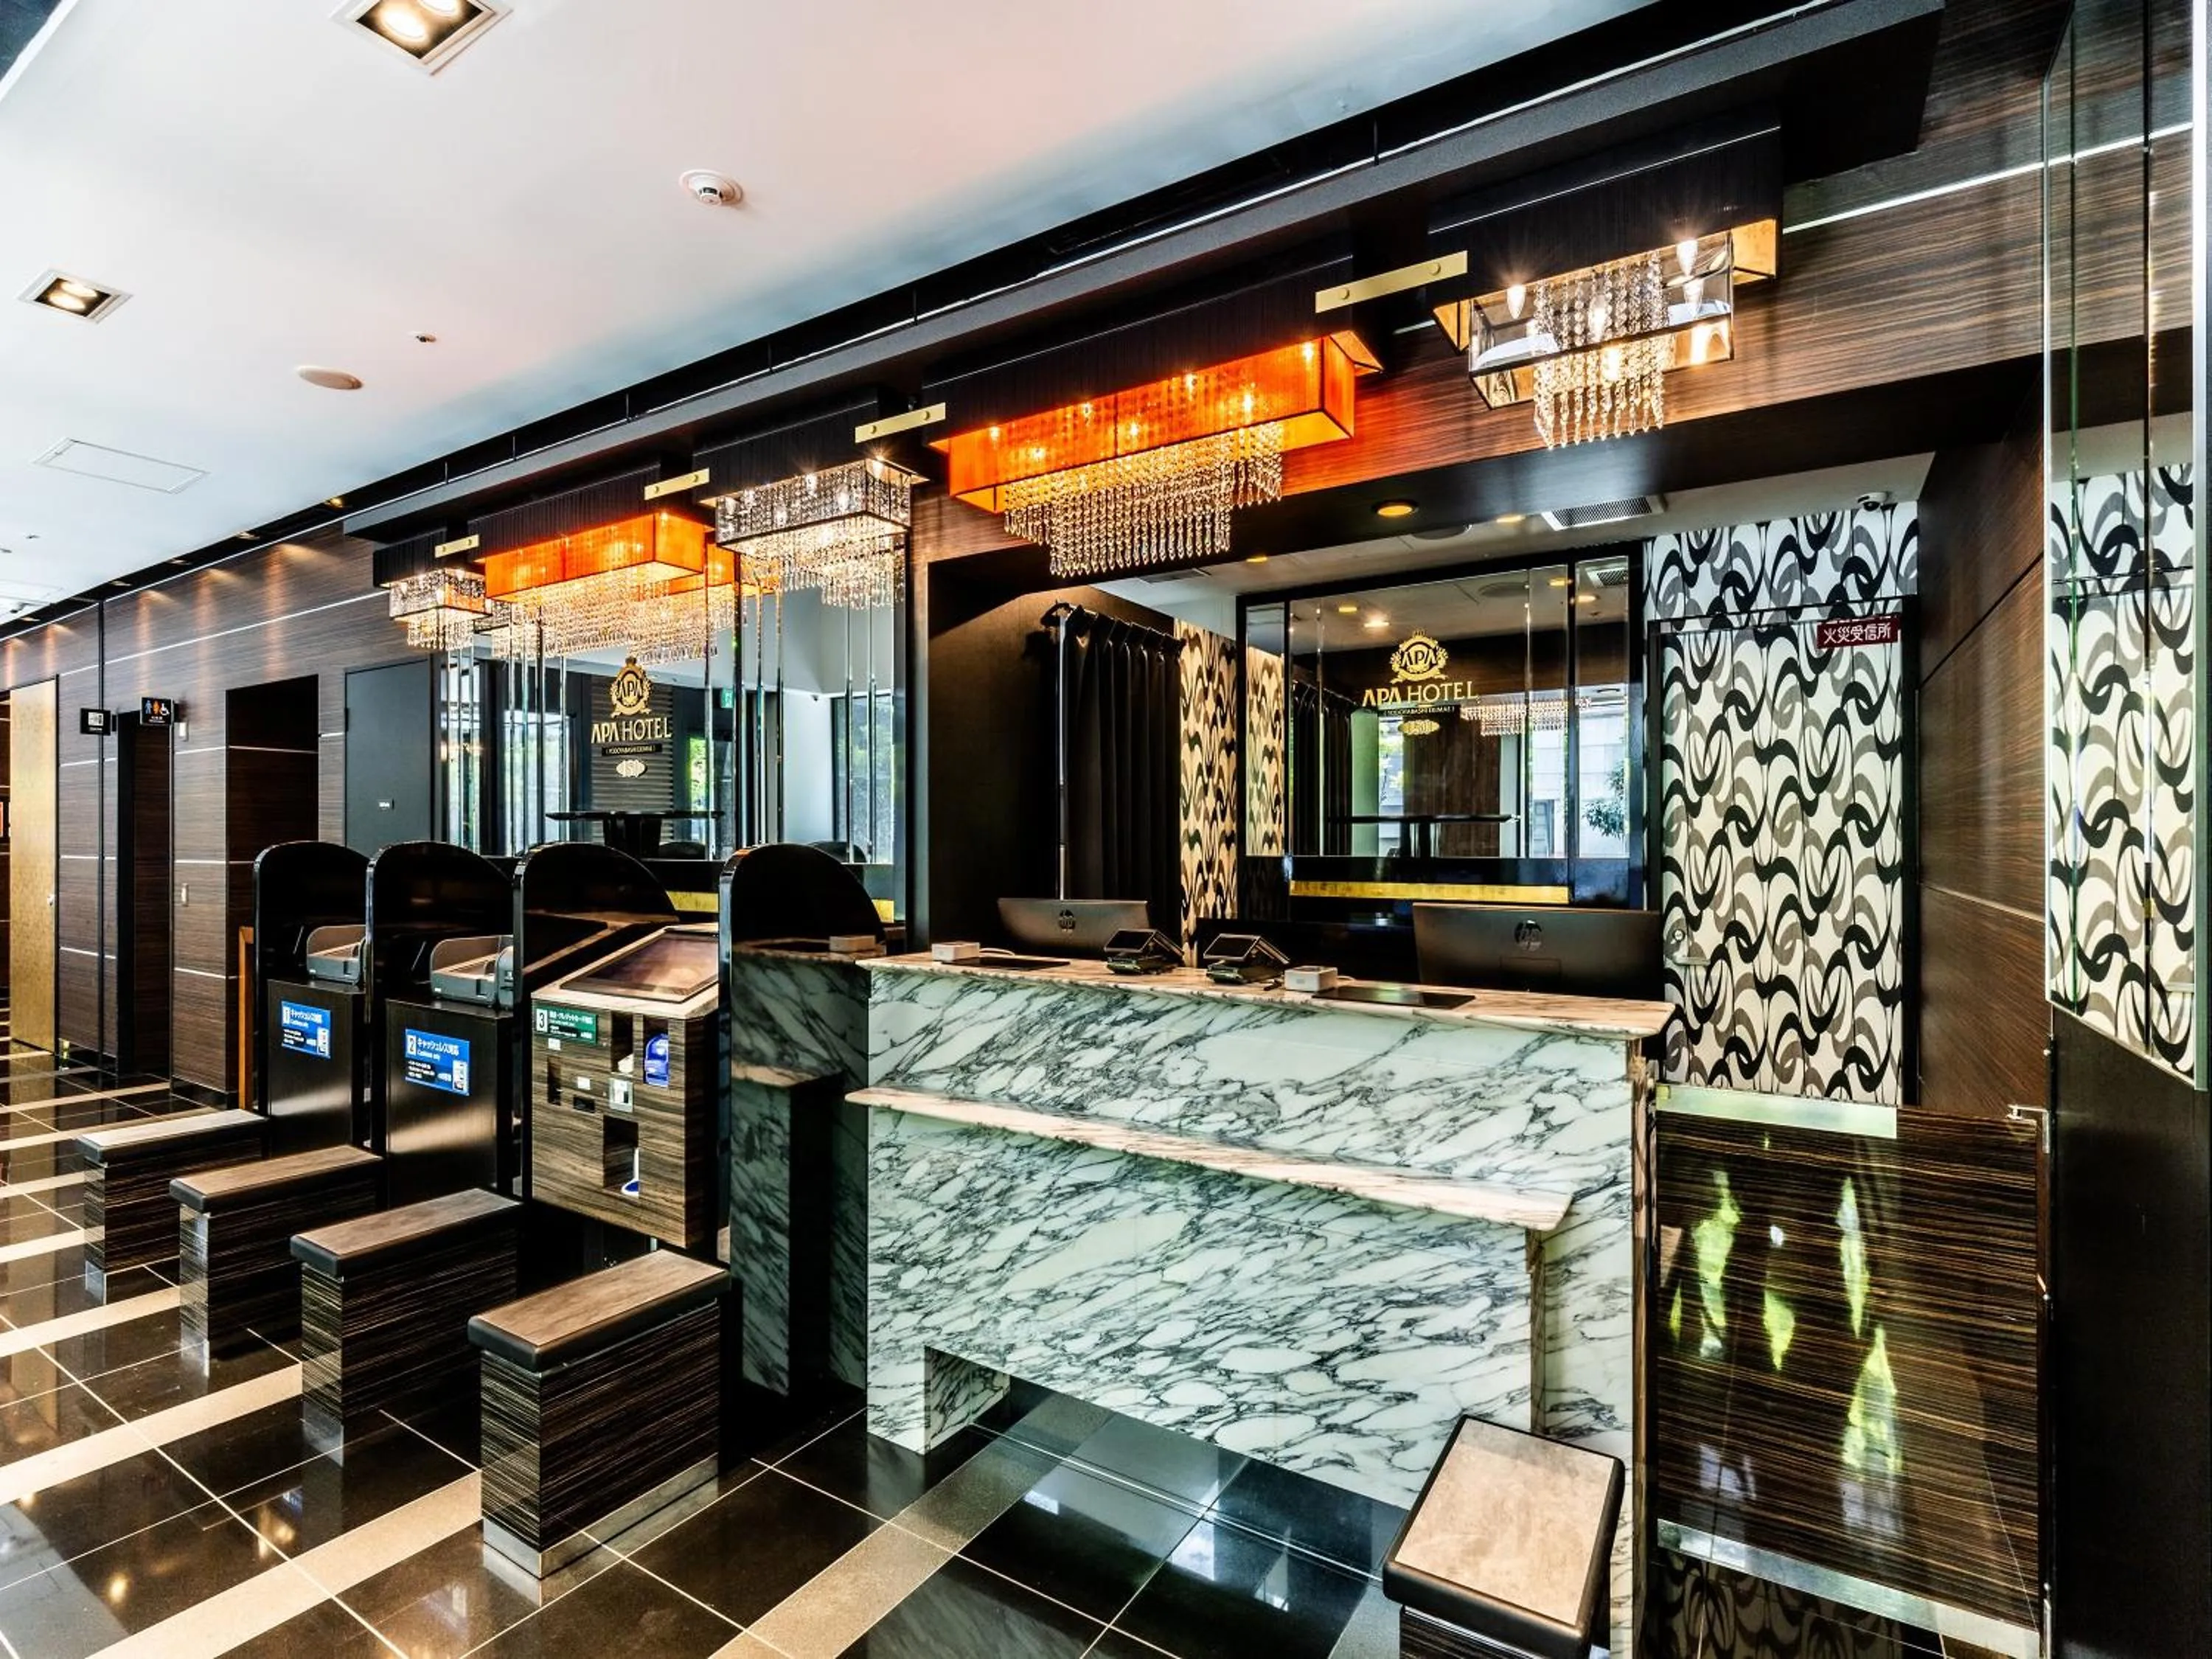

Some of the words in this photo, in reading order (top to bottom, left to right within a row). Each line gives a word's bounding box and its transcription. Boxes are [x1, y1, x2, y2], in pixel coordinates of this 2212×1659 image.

[1823, 622, 1891, 645] 火災受信所
[1401, 647, 1437, 667] APA
[616, 678, 643, 698] APA
[1362, 686, 1402, 707] APA
[1407, 681, 1478, 703] HOTEL
[591, 722, 619, 744] APA
[622, 717, 672, 741] HOTEL
[539, 1012, 545, 1029] 3
[409, 1037, 414, 1052] 2
